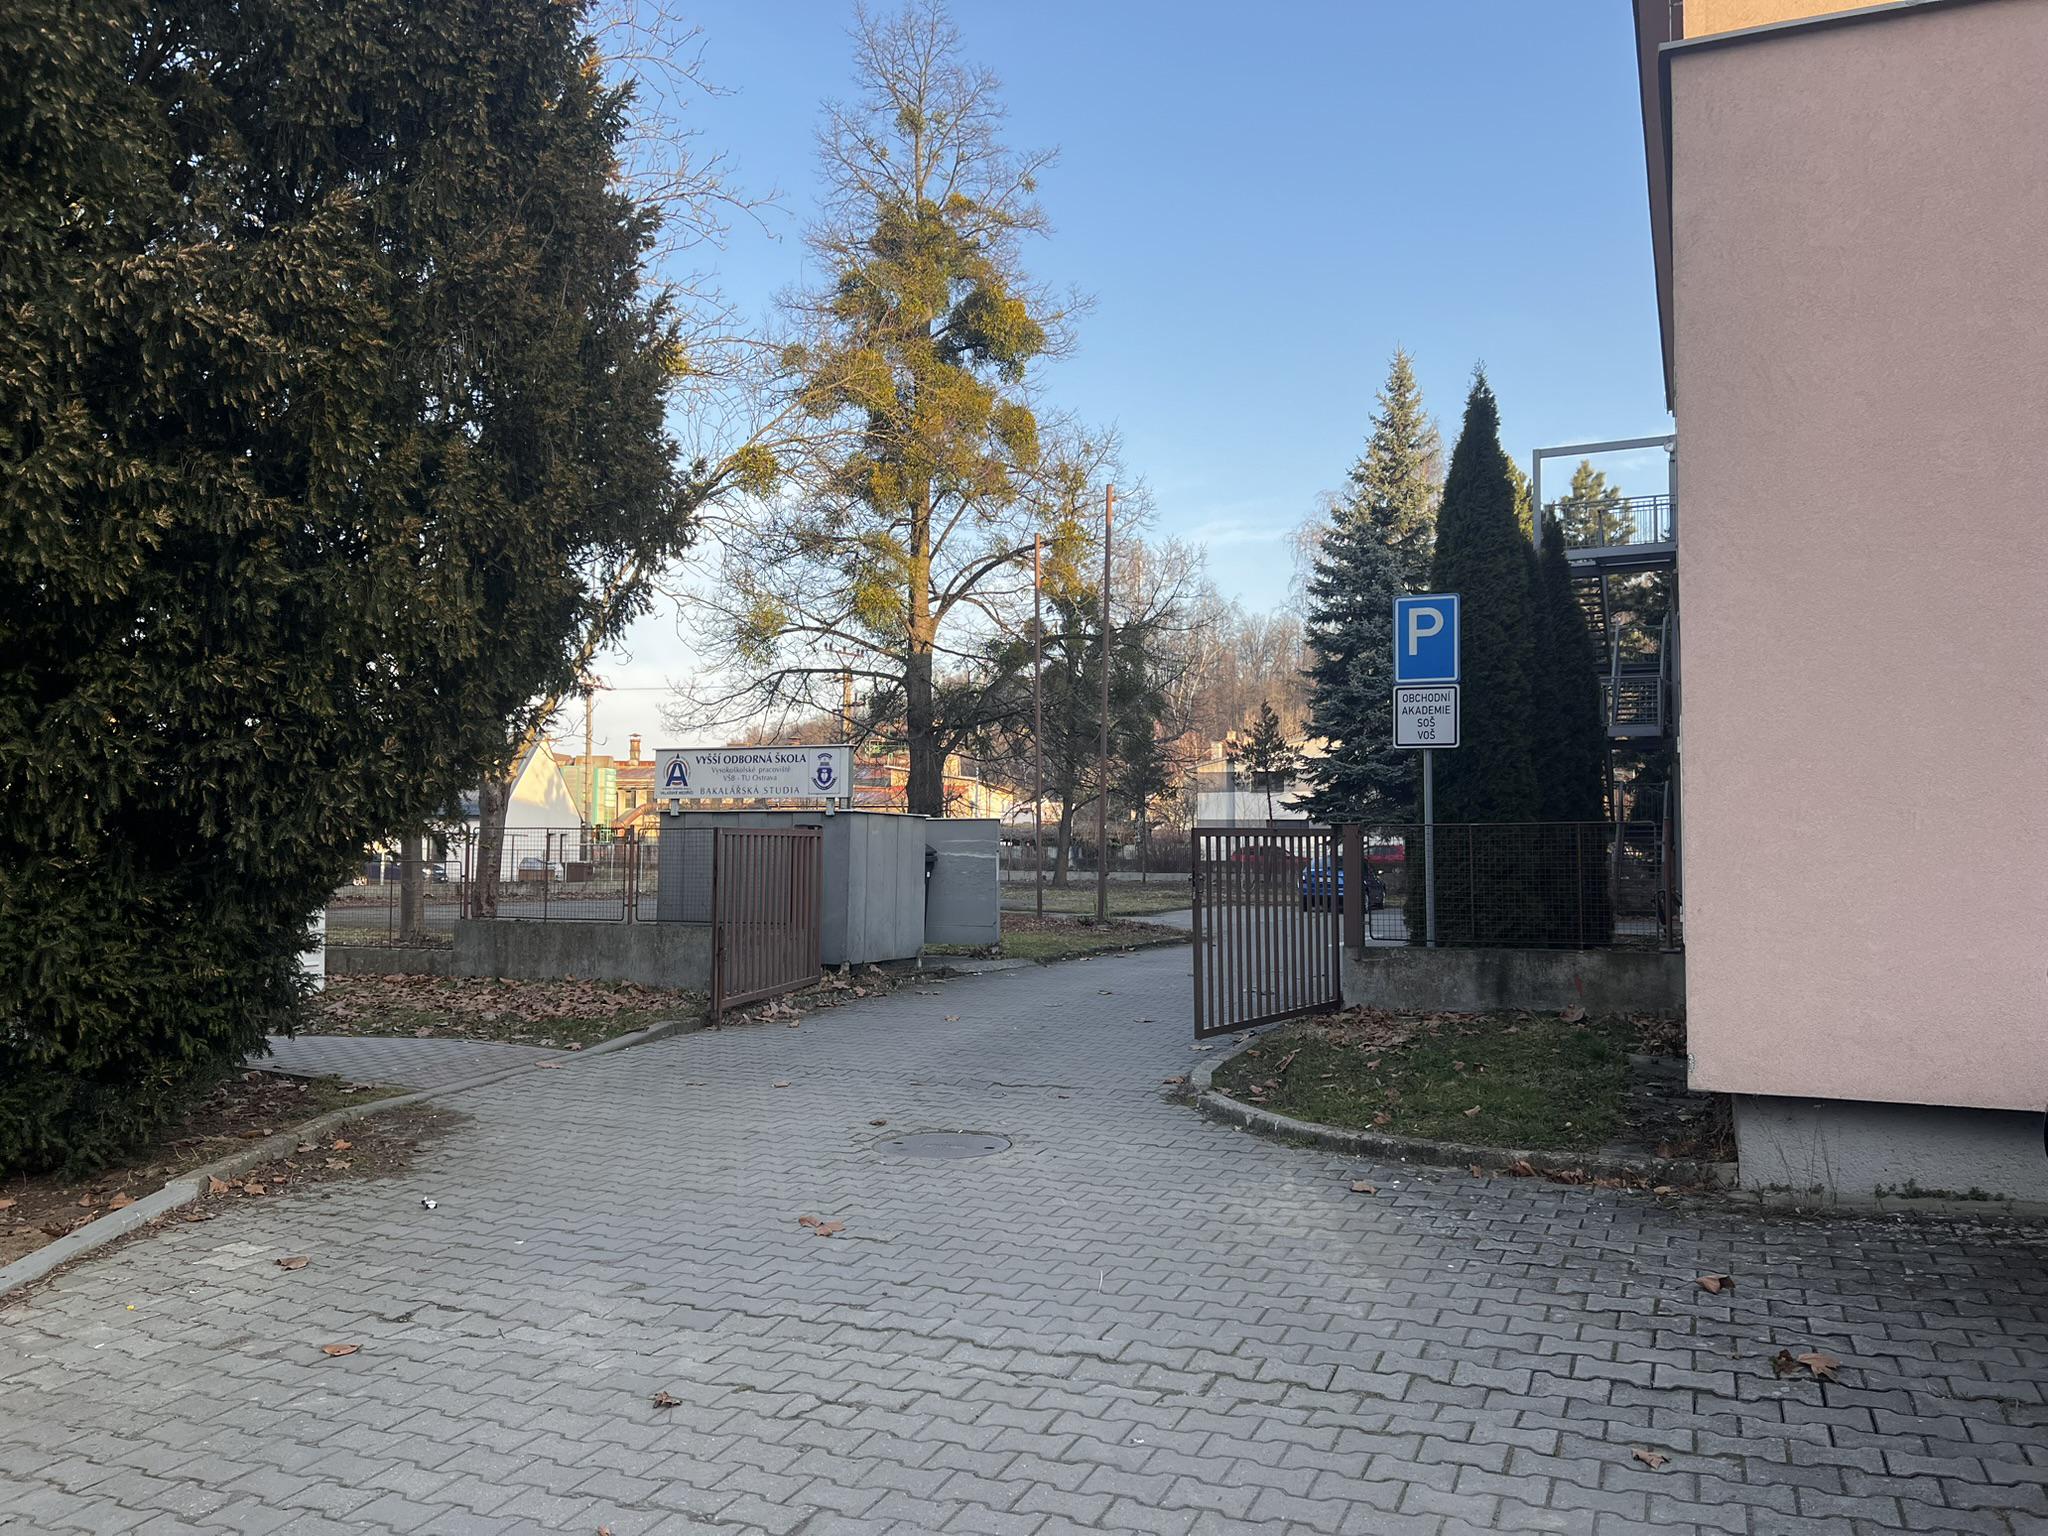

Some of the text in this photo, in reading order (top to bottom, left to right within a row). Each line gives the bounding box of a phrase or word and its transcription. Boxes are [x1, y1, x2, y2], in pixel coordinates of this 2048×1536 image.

[1408, 607, 1444, 656] P
[1402, 691, 1451, 703] OBCHODNÍ
[1401, 705, 1451, 715] AKADEMIE
[1417, 716, 1436, 728] SOŠ
[1417, 729, 1436, 740] VOŠ
[696, 753, 721, 764] VYŠŠÍ
[723, 752, 772, 764] ODBORNÁ
[774, 752, 807, 763] ŠKOLA
[700, 786, 760, 795] BAKALÁŘSKÁ
[763, 786, 801, 795] STUDIA
